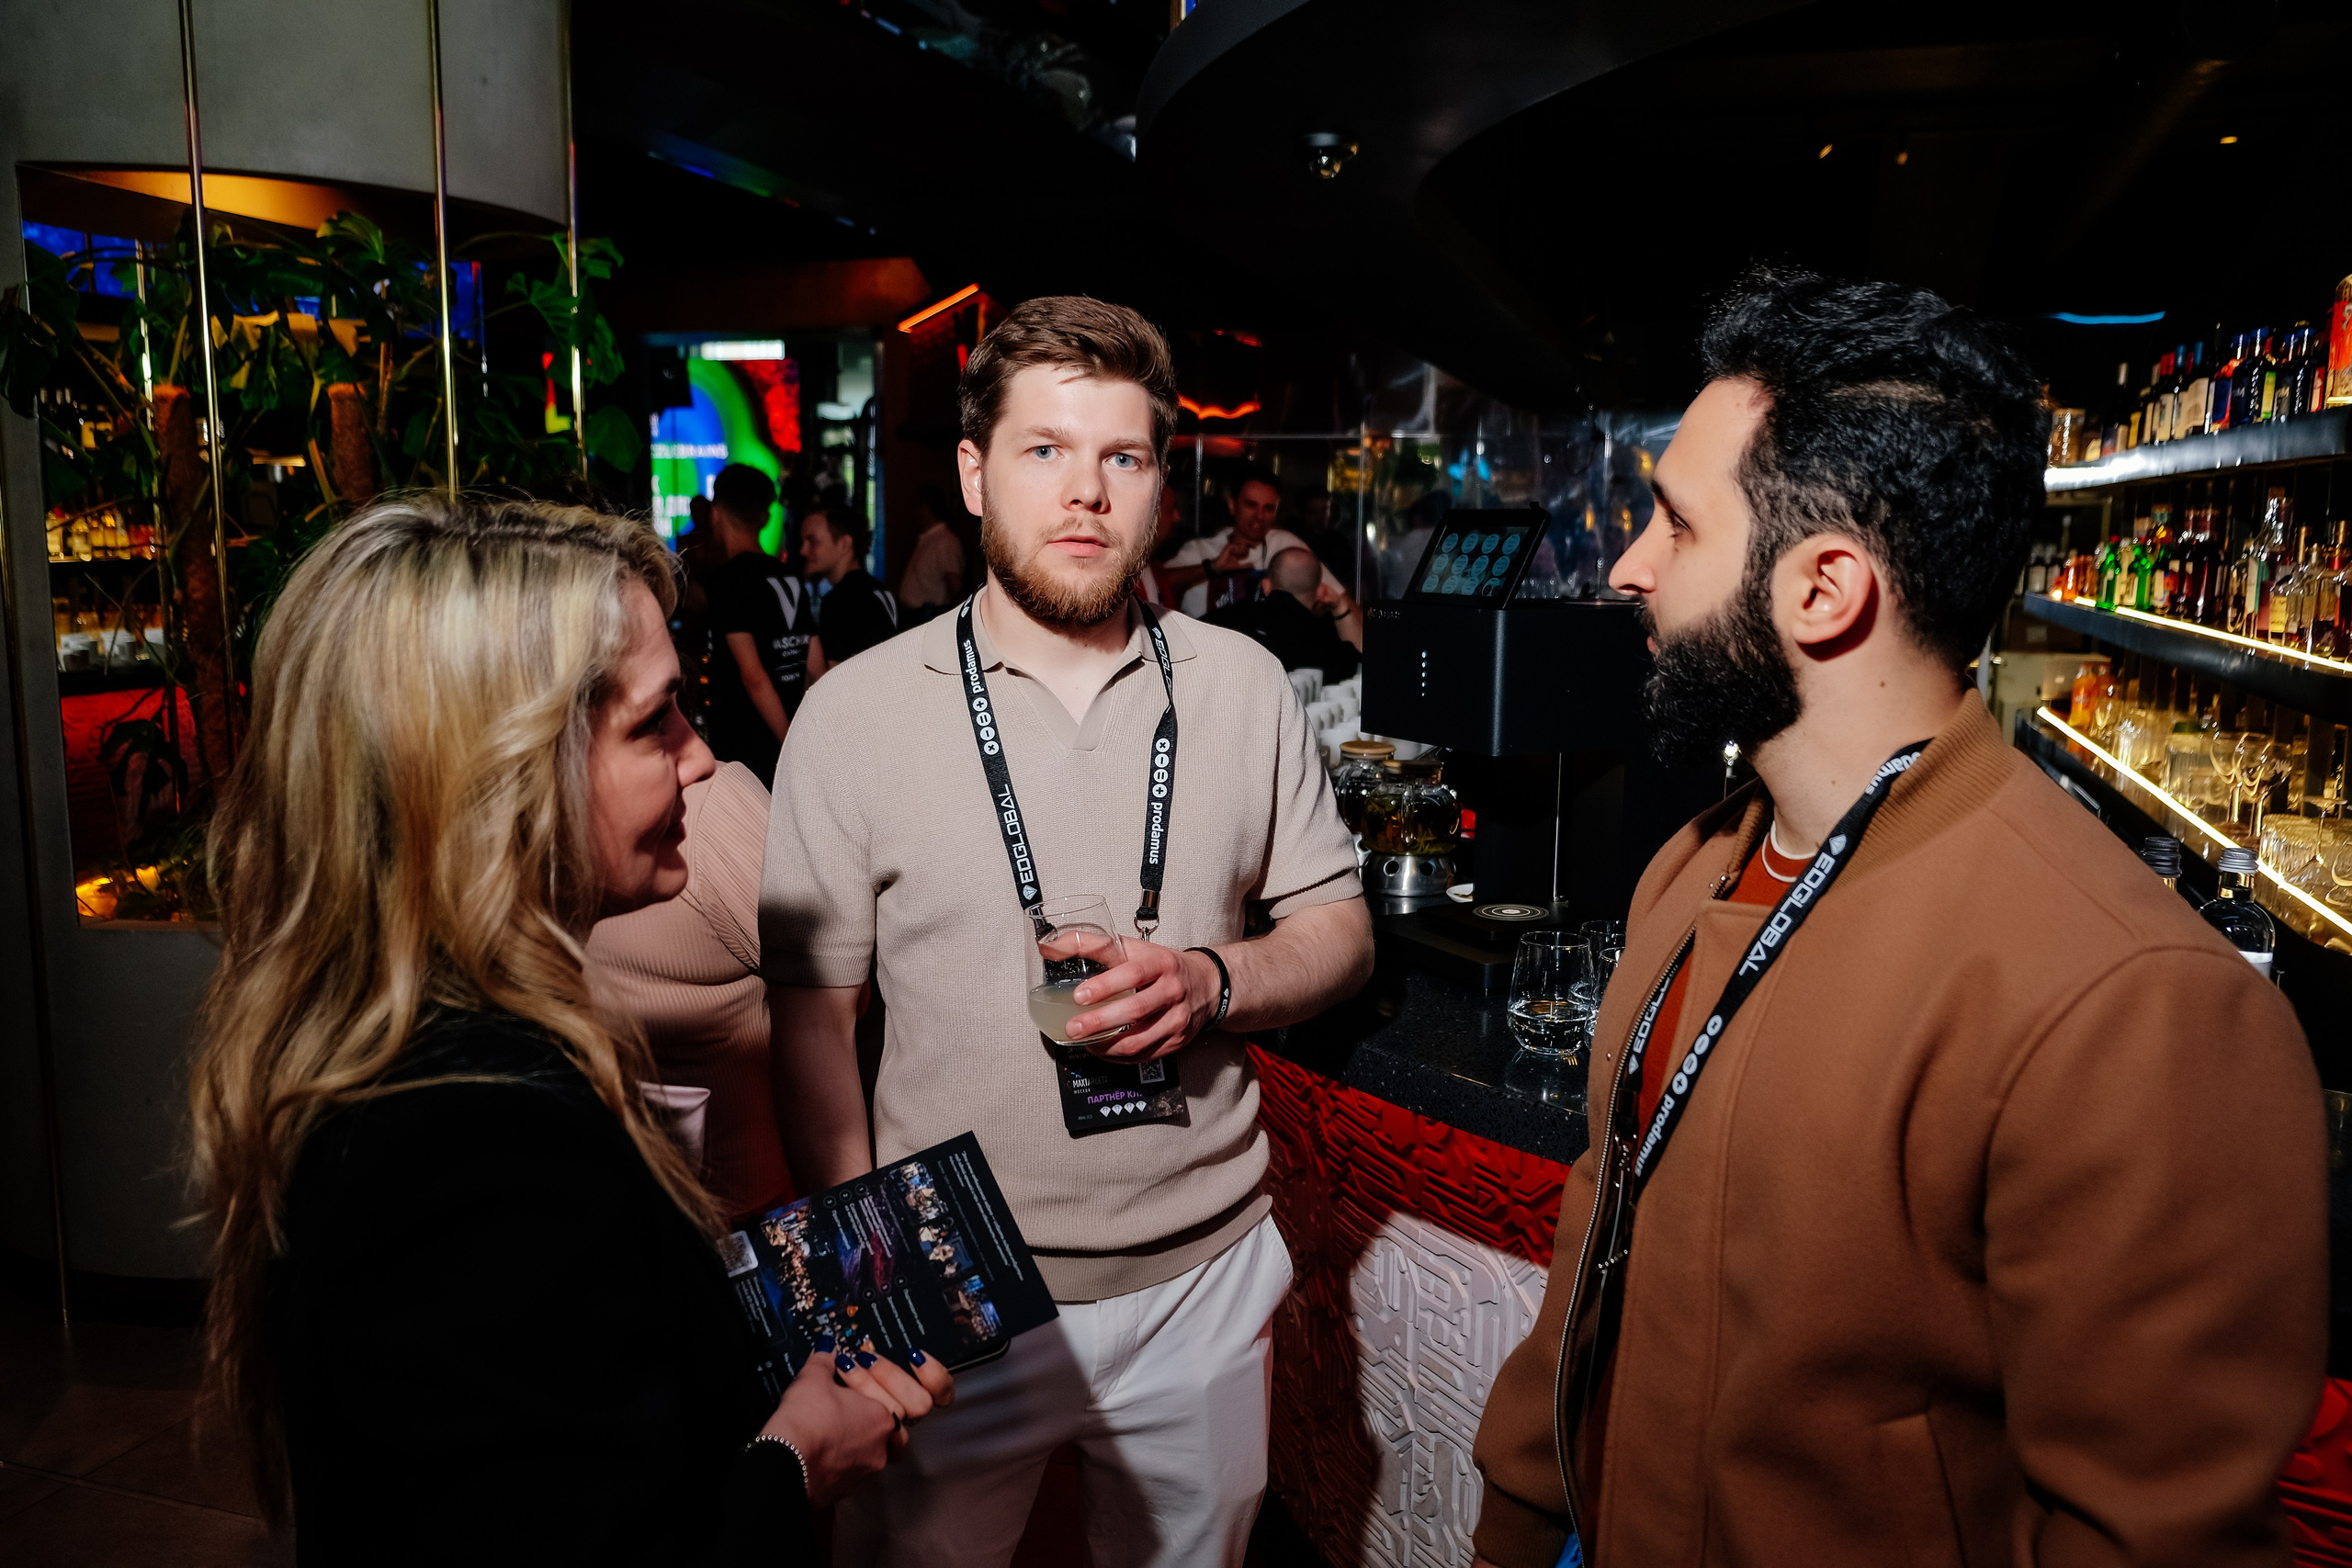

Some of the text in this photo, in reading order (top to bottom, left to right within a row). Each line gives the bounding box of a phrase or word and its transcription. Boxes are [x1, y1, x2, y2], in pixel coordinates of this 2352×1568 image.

[963, 639, 985, 694] prodamus
[998, 784, 1035, 884] EDGLOBAL
[1148, 802, 1164, 864] prodamus
[1738, 852, 1836, 976] EDGLOBAL
[1087, 1091, 1125, 1104] ПАРТНЁР
[1634, 1093, 1676, 1178] prodamus
